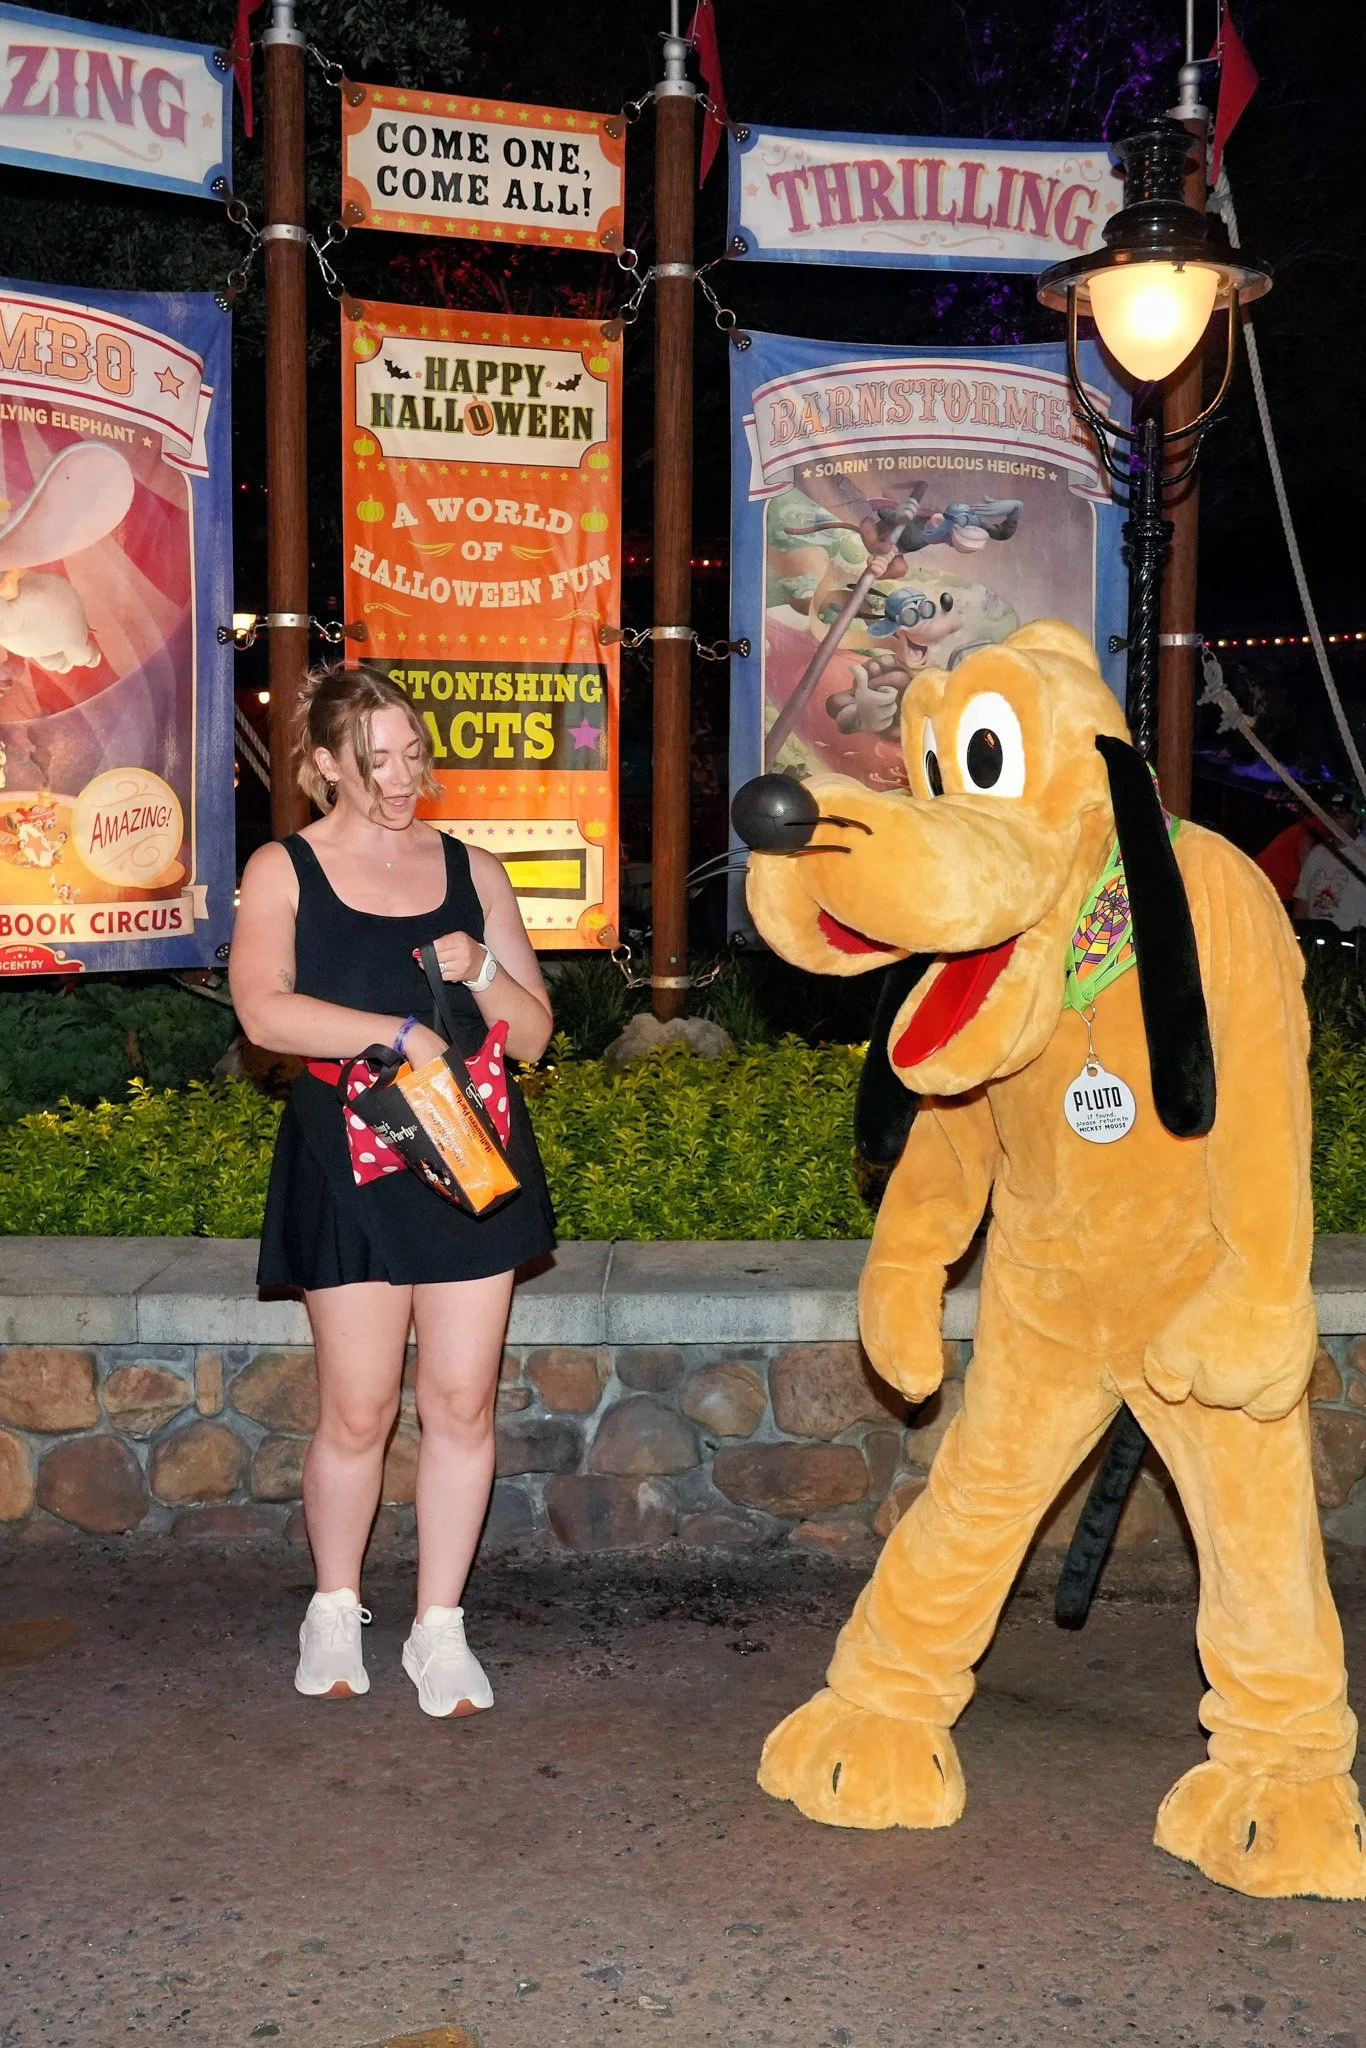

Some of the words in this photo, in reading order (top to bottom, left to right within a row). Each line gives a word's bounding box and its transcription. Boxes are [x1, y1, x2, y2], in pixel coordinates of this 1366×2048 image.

[3, 44, 190, 146] ZING
[376, 122, 489, 164] COME
[502, 137, 592, 181] ONE,
[376, 165, 489, 206] COME
[501, 180, 593, 218] ALL!
[767, 157, 1101, 251] THRILLING
[424, 355, 546, 397] HAPPY
[51, 410, 136, 444] ELEPHANT
[370, 392, 594, 443] HALLOWEEN
[877, 456, 895, 471] TO
[898, 455, 984, 472] RIDICULOUS
[987, 460, 1047, 480] HEIGHTS
[392, 502, 419, 529] A
[426, 497, 574, 535] WORLD
[461, 540, 503, 562] OF
[350, 544, 541, 608] HALLOWEEN
[548, 554, 612, 601] FUN
[388, 669, 603, 703] STONISHING
[89, 806, 173, 854] AMAZING!
[0, 912, 76, 937] BOOK
[90, 907, 183, 934] CIRCUS
[456, 1093, 471, 1116] Party
[1073, 1086, 1122, 1112] PLUTO
[390, 1126, 415, 1143] Party
[468, 1115, 493, 1153] Halloween
[1076, 1120, 1096, 1128] please
[1104, 1122, 1126, 1130] MOUSE
